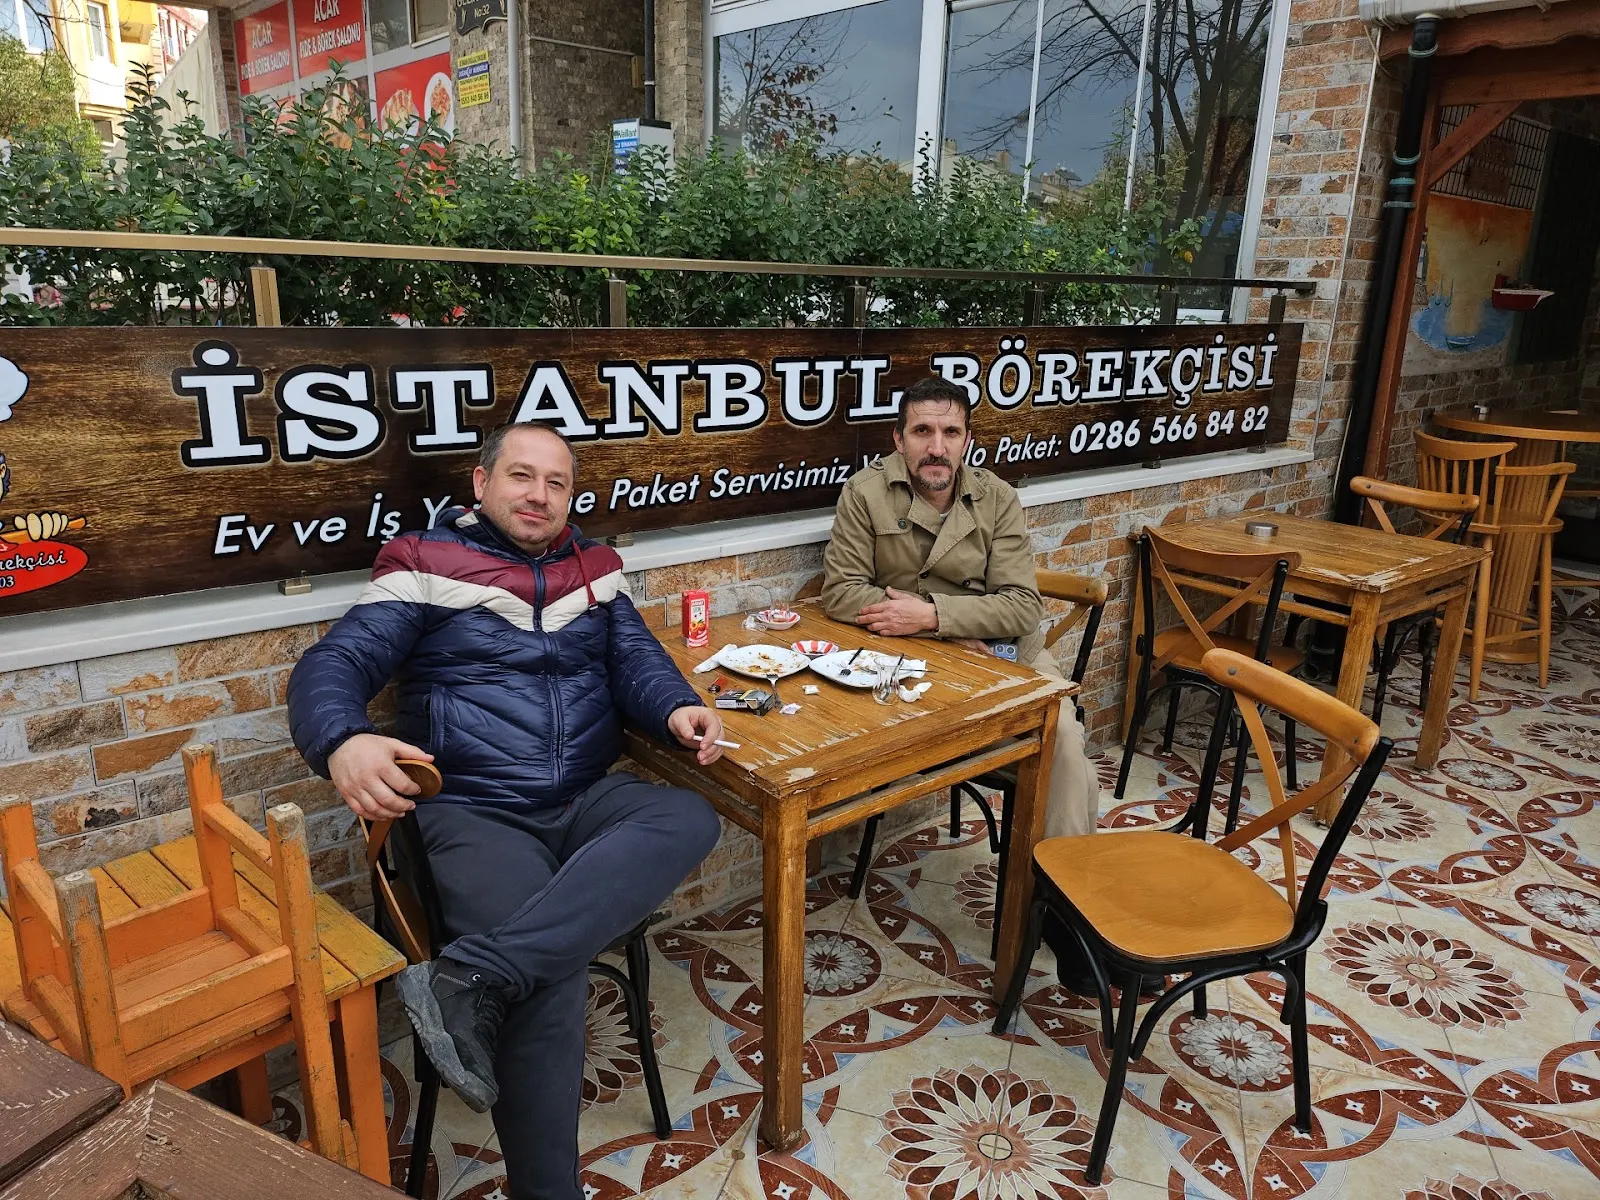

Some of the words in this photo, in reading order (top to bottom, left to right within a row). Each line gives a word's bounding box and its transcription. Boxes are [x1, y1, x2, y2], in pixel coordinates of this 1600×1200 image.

[335, 22, 361, 47] SALONU
[180, 347, 902, 461] İSTANBUL
[932, 332, 1279, 408] BÖREKÇİSİ
[214, 513, 275, 555] Ev
[292, 515, 347, 546] ve
[366, 492, 402, 545] İş
[609, 473, 701, 510] Paket
[709, 457, 851, 498] Servisimiz
[965, 439, 987, 467] lo
[994, 432, 1063, 464] Paket:
[1069, 418, 1141, 454] 0286
[1149, 413, 1198, 445] 566
[1205, 409, 1235, 438] 84
[1240, 405, 1269, 433] 82
